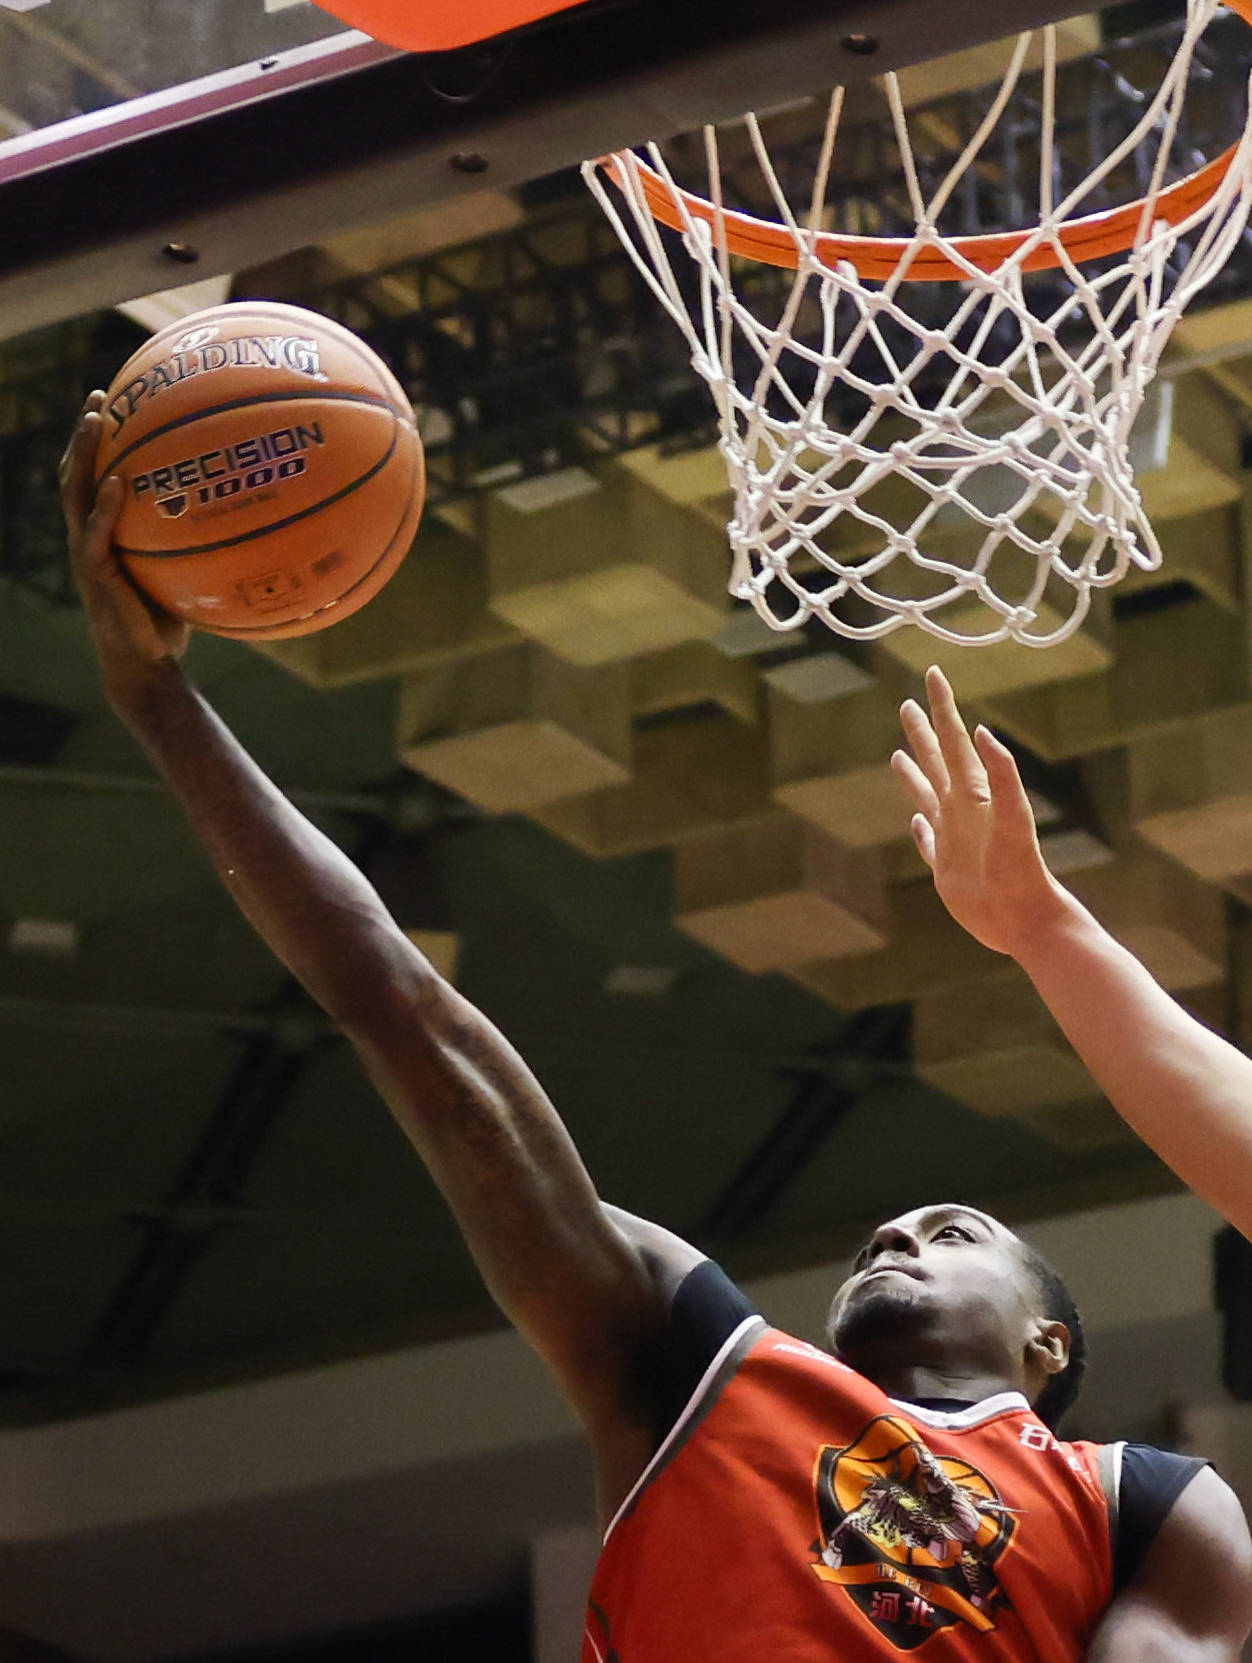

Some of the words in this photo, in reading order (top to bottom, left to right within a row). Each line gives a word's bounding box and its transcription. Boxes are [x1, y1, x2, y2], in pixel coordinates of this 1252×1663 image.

[110, 336, 321, 438] SPALDING
[131, 421, 325, 496] PRECISION
[197, 457, 308, 505] 1000
